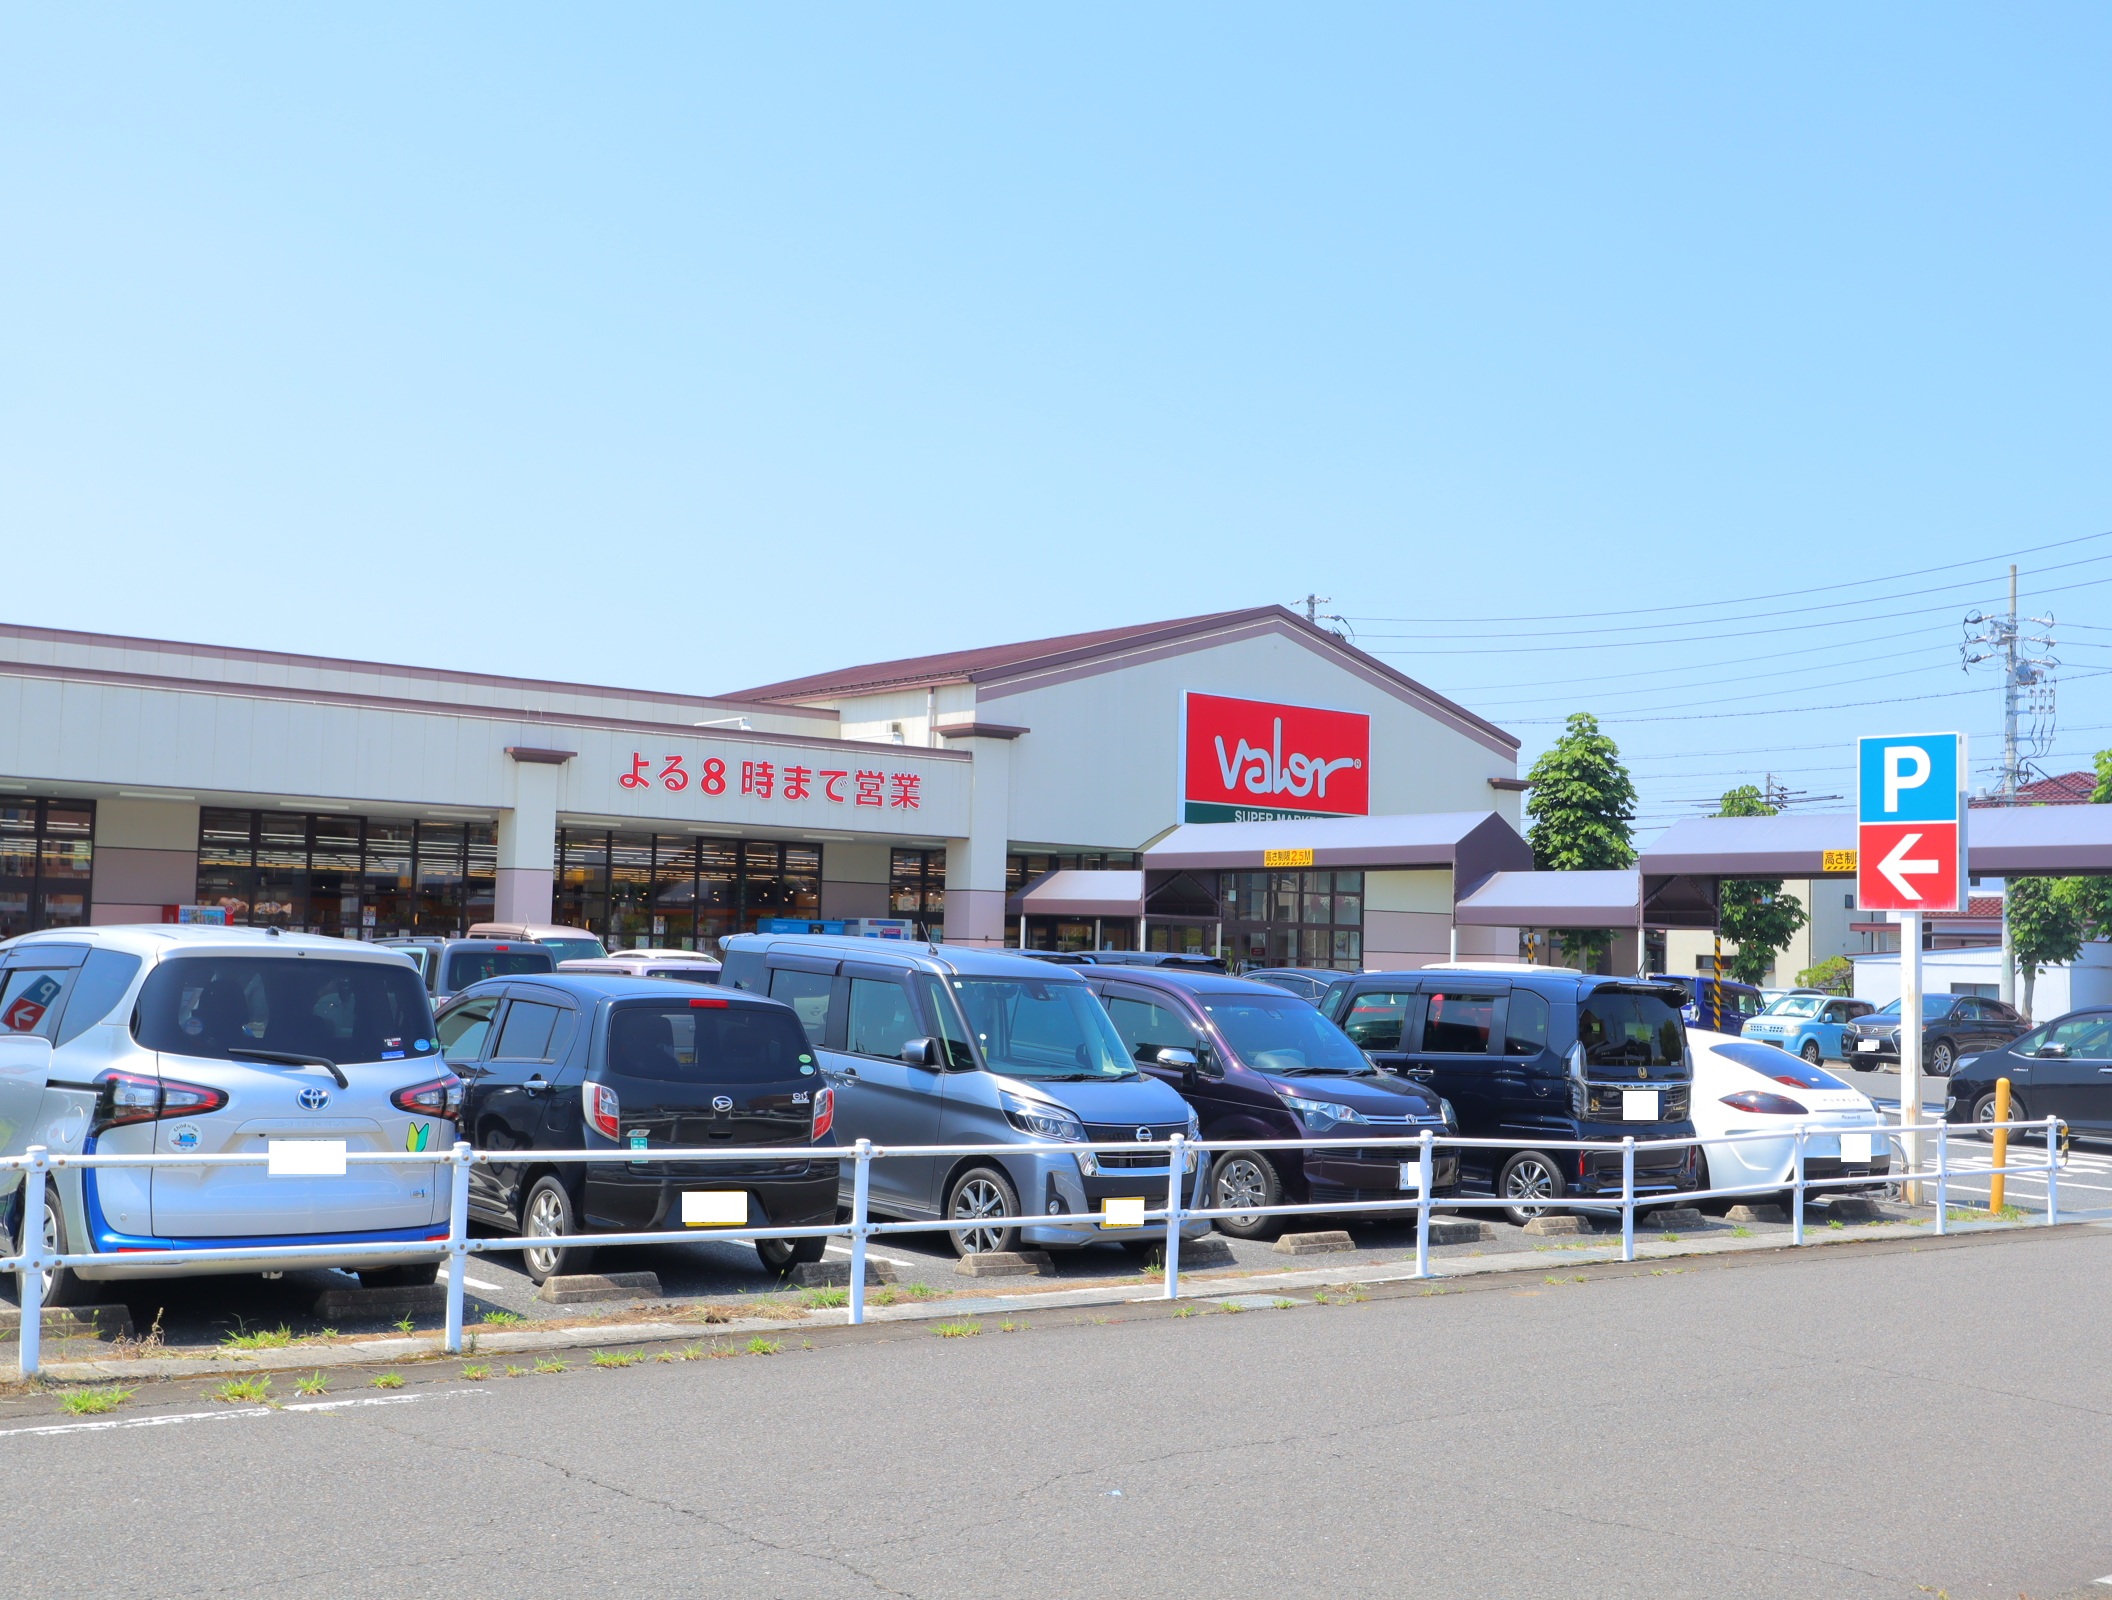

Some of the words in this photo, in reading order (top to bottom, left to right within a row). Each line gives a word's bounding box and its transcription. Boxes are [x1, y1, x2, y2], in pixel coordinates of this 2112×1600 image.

[618, 751, 922, 810] よる8時まで営業
[1884, 745, 1931, 812] P
[1234, 810, 1273, 823] SUPER
[1825, 851, 1857, 865] 高さ制
